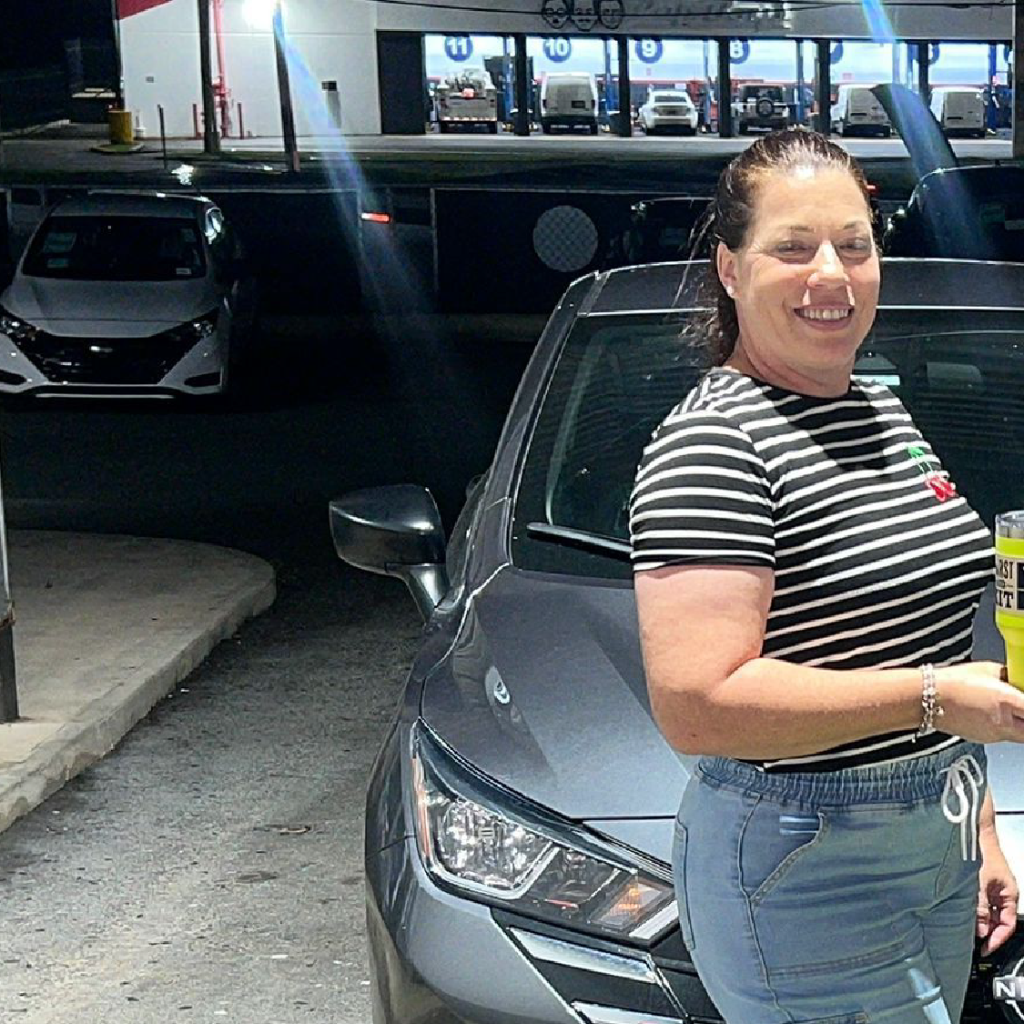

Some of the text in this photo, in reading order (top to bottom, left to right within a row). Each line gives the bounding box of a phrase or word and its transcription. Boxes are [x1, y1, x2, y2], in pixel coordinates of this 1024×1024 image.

[446, 37, 468, 56] 11
[545, 38, 568, 56] 10
[641, 38, 658, 58] 9
